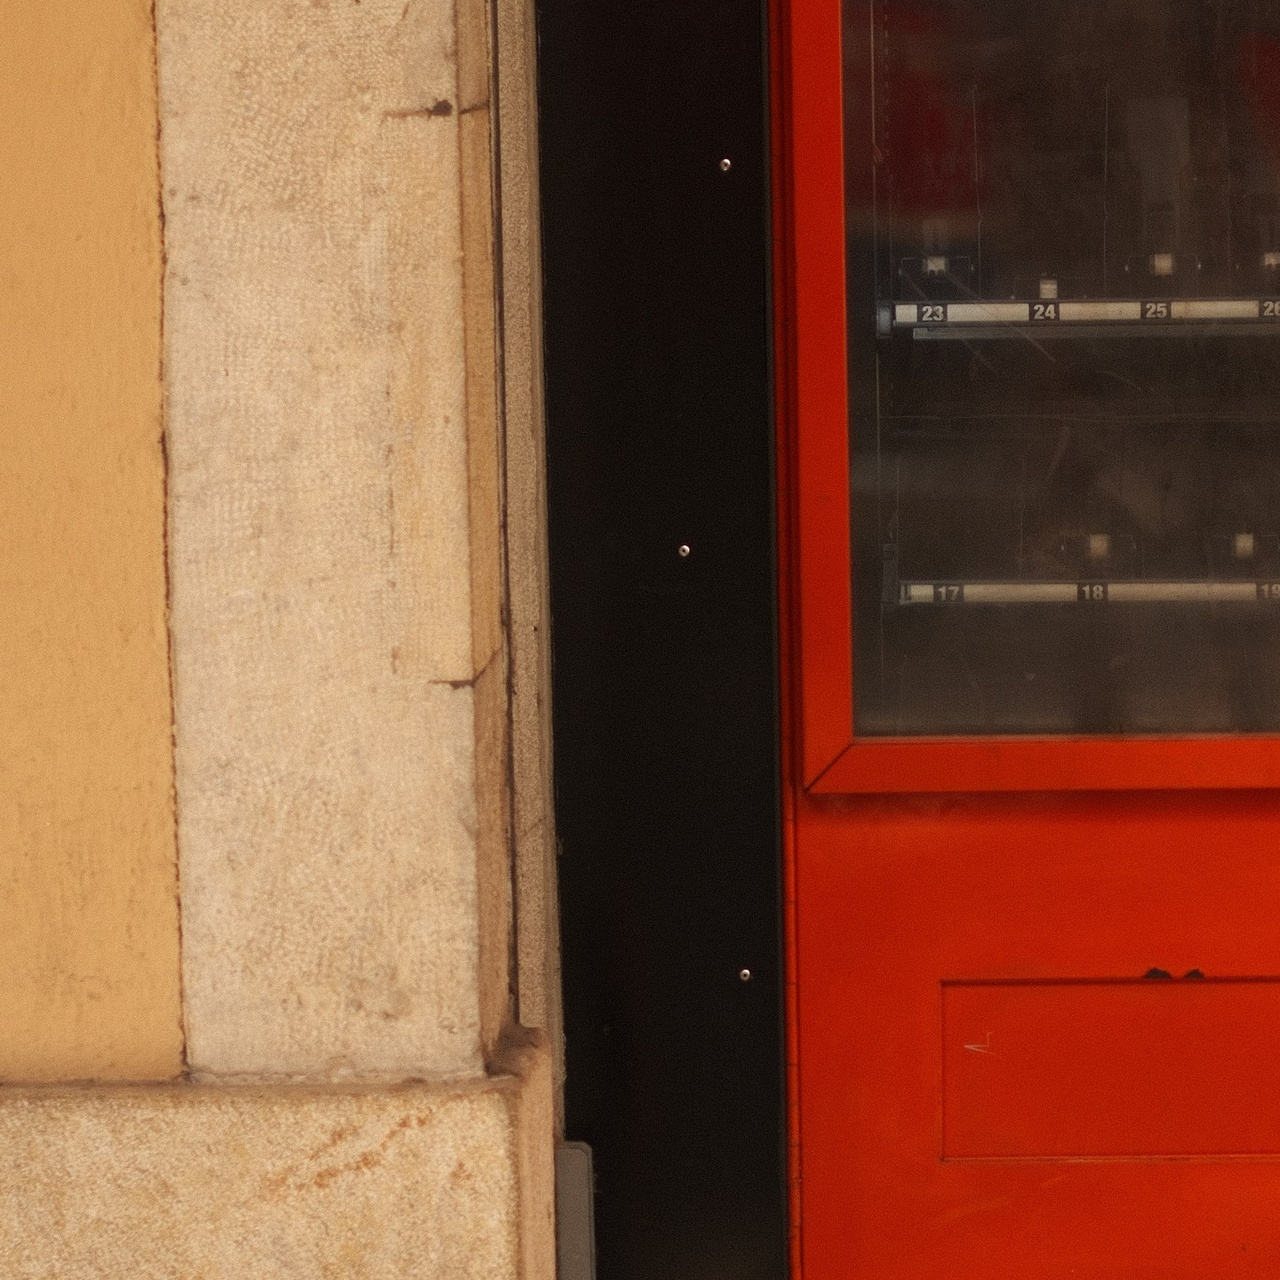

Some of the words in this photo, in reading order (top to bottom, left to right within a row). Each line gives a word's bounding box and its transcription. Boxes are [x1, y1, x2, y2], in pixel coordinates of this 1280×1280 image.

[922, 306, 944, 321] 23
[1034, 305, 1056, 320] 24
[1145, 303, 1167, 318] 25
[938, 586, 960, 601] 17
[1082, 585, 1103, 600] 18
